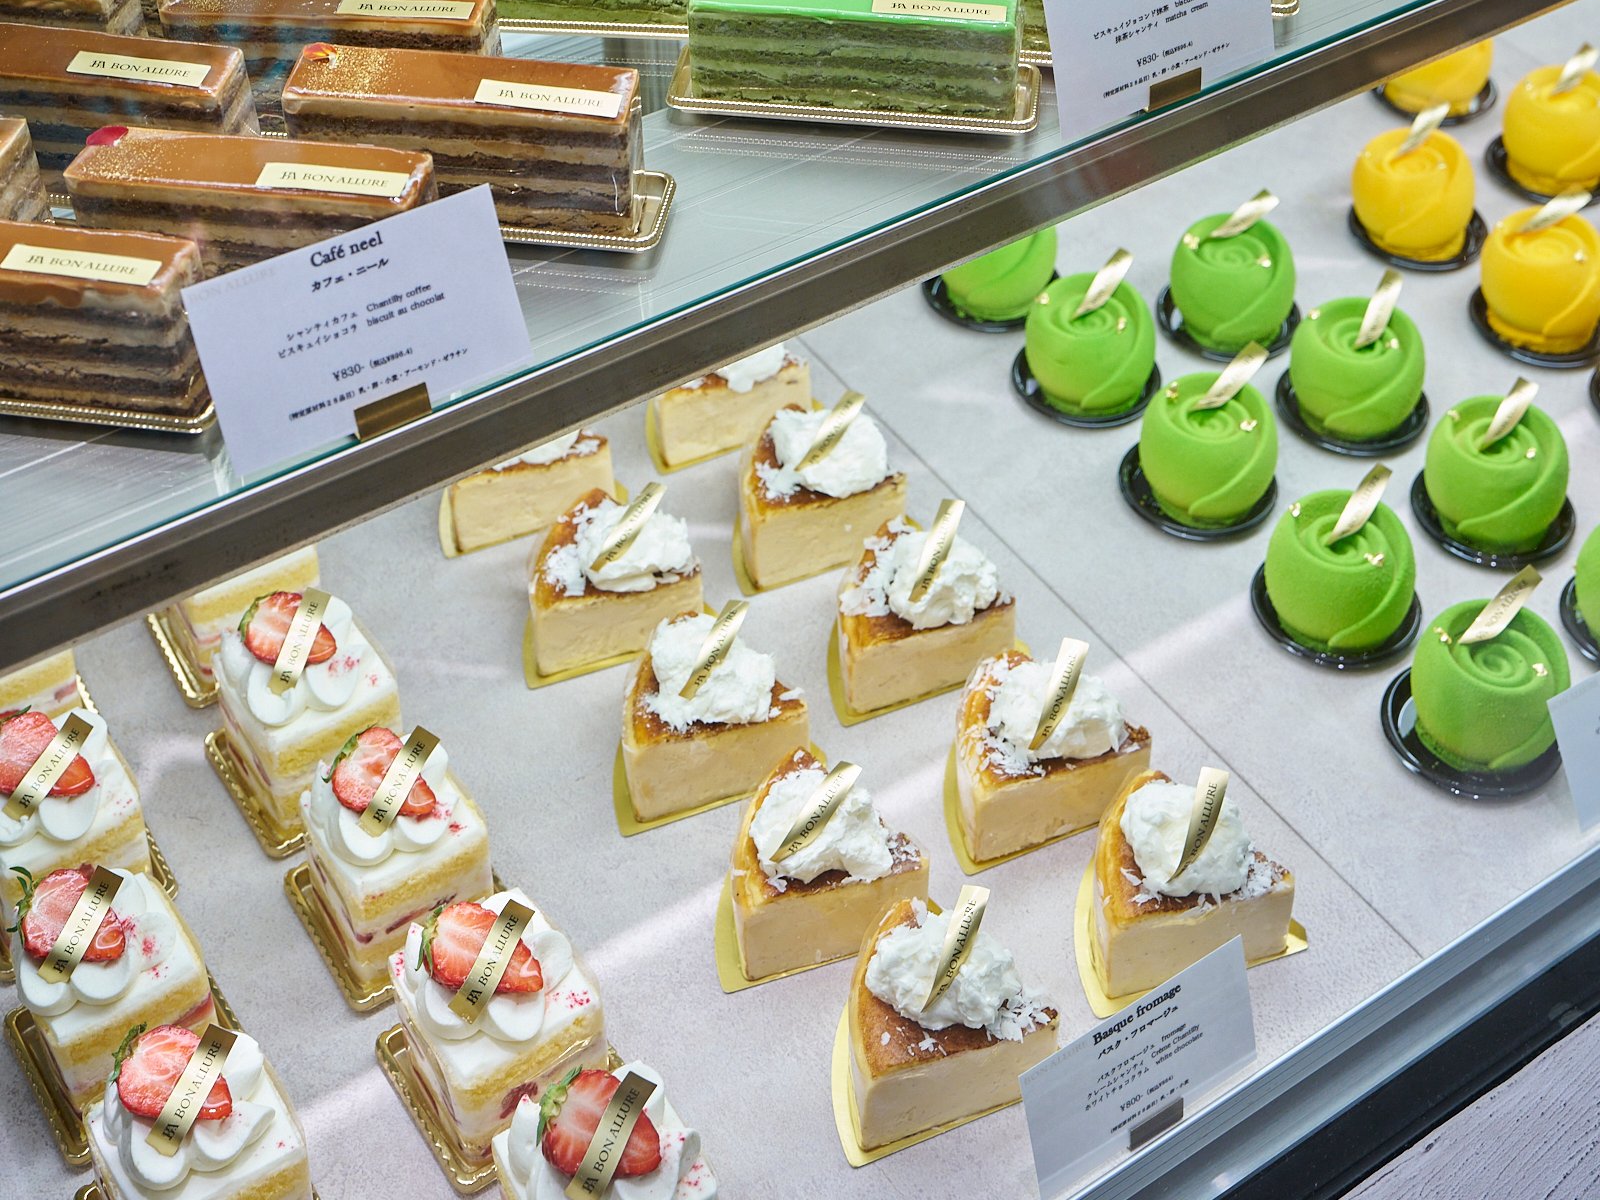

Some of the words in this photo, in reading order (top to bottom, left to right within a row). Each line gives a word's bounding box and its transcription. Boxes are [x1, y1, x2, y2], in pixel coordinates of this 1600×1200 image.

[379, 4, 407, 12] BON
[409, 5, 457, 13] ALLURE
[912, 4, 941, 12] BON
[943, 6, 992, 16] ALLURE
[1165, 9, 1188, 23] matcha
[110, 62, 141, 73] BON
[142, 64, 192, 78] ALLURE
[520, 91, 551, 101] BON
[552, 95, 602, 108] ALLURE
[302, 172, 336, 183] BON
[336, 176, 389, 188] ALLURE
[310, 244, 346, 267] Café
[349, 230, 383, 255] neel
[49, 257, 83, 270] BON
[84, 260, 137, 276] ALLURE
[366, 293, 403, 312] Chantilly
[405, 284, 431, 298] coffee
[366, 311, 395, 327] biscuit
[397, 307, 408, 316] au
[410, 292, 445, 311] chocolat
[287, 643, 302, 666] BON
[703, 646, 721, 673] BON
[1049, 694, 1064, 722] BON
[31, 765, 53, 793] BON
[50, 726, 81, 768] ALLURE
[383, 780, 403, 807] BON
[800, 811, 821, 839] BON
[1190, 827, 1206, 857] BON
[1200, 782, 1218, 829] ALLURE
[64, 924, 86, 956] BON
[81, 881, 110, 927] ALLURE
[946, 947, 962, 979] BON
[956, 898, 977, 949] ALLURE
[478, 959, 498, 987] BON
[1092, 1013, 1135, 1046] Basque
[1136, 983, 1182, 1018] fromage
[1161, 1023, 1187, 1042] fromage
[1155, 1051, 1174, 1065] white
[1174, 1032, 1203, 1054] chocolate
[174, 1087, 197, 1120] BON
[192, 1040, 223, 1091] ALLURE
[593, 1137, 616, 1174] BON
[610, 1087, 641, 1140] ALLURE
